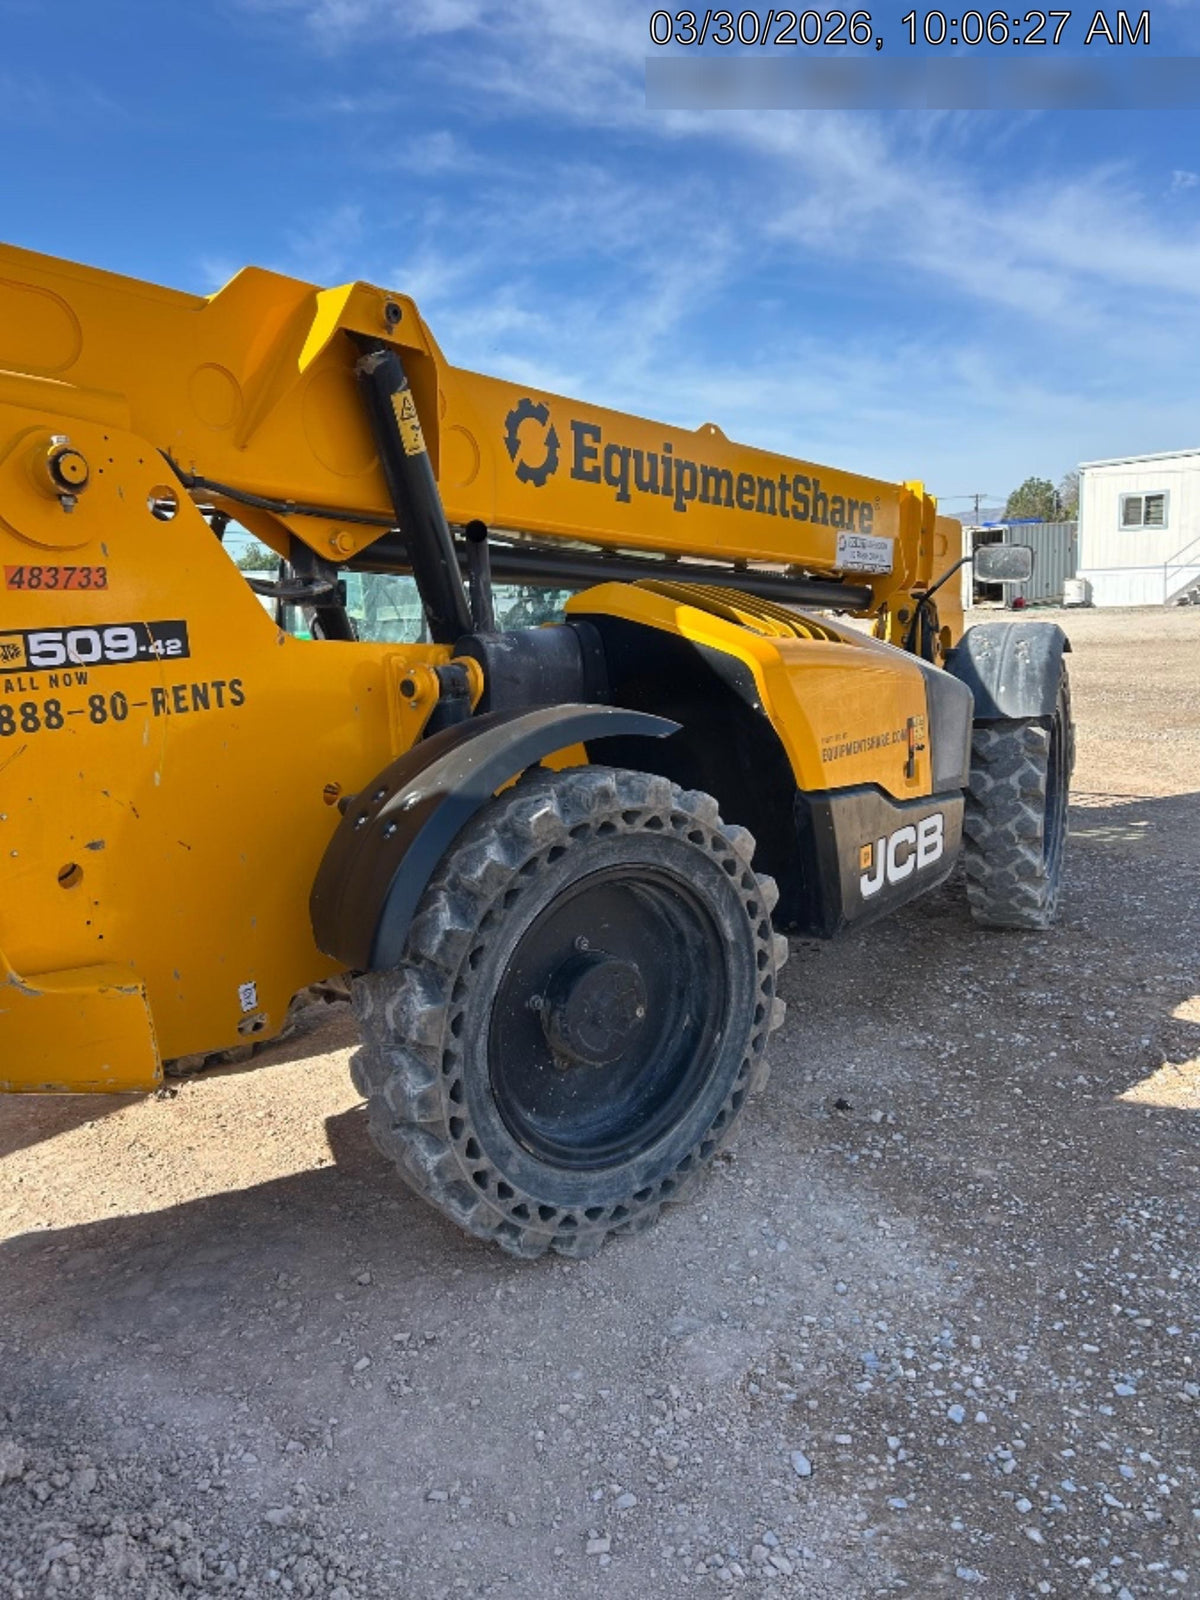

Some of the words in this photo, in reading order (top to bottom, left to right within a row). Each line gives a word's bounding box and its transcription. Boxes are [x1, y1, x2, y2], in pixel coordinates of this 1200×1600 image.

[570, 418, 875, 535] EquipmentShare
[8, 566, 108, 590] 483733
[49, 671, 88, 689] NOW
[859, 812, 944, 900] JCB
